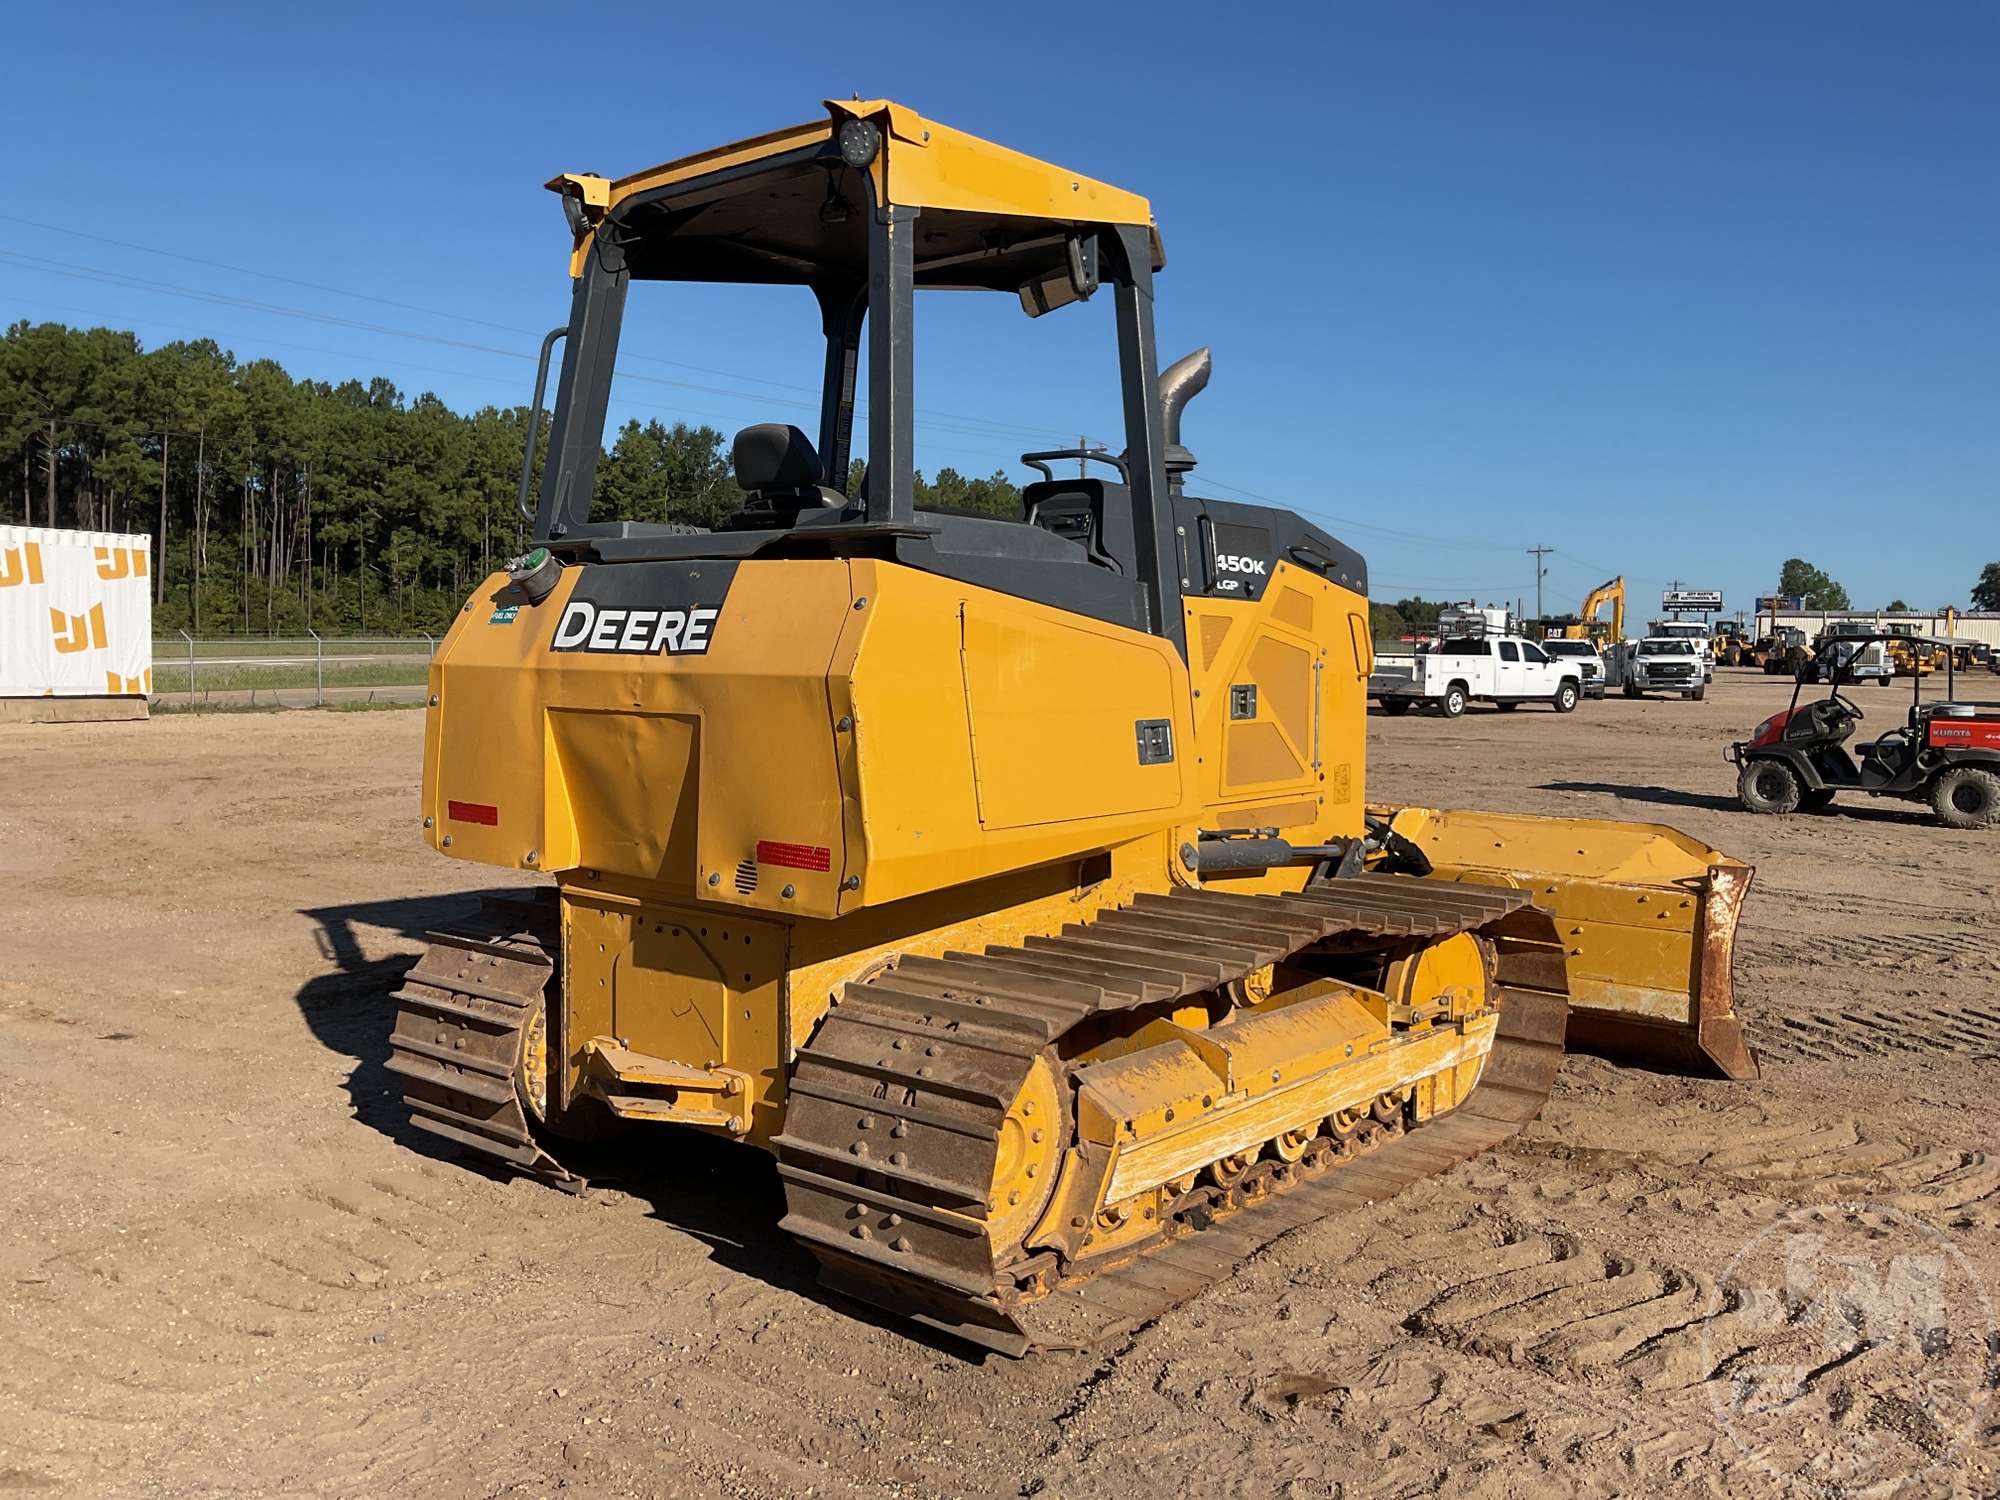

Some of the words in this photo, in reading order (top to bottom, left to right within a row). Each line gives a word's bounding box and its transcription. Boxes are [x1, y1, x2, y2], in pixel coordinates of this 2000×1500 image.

[1217, 554, 1266, 576] 450K
[1216, 579, 1239, 590] LGP
[553, 602, 718, 651] DEERE
[1547, 628, 1563, 638] CAT
[1933, 729, 1971, 737] KUBOTA
